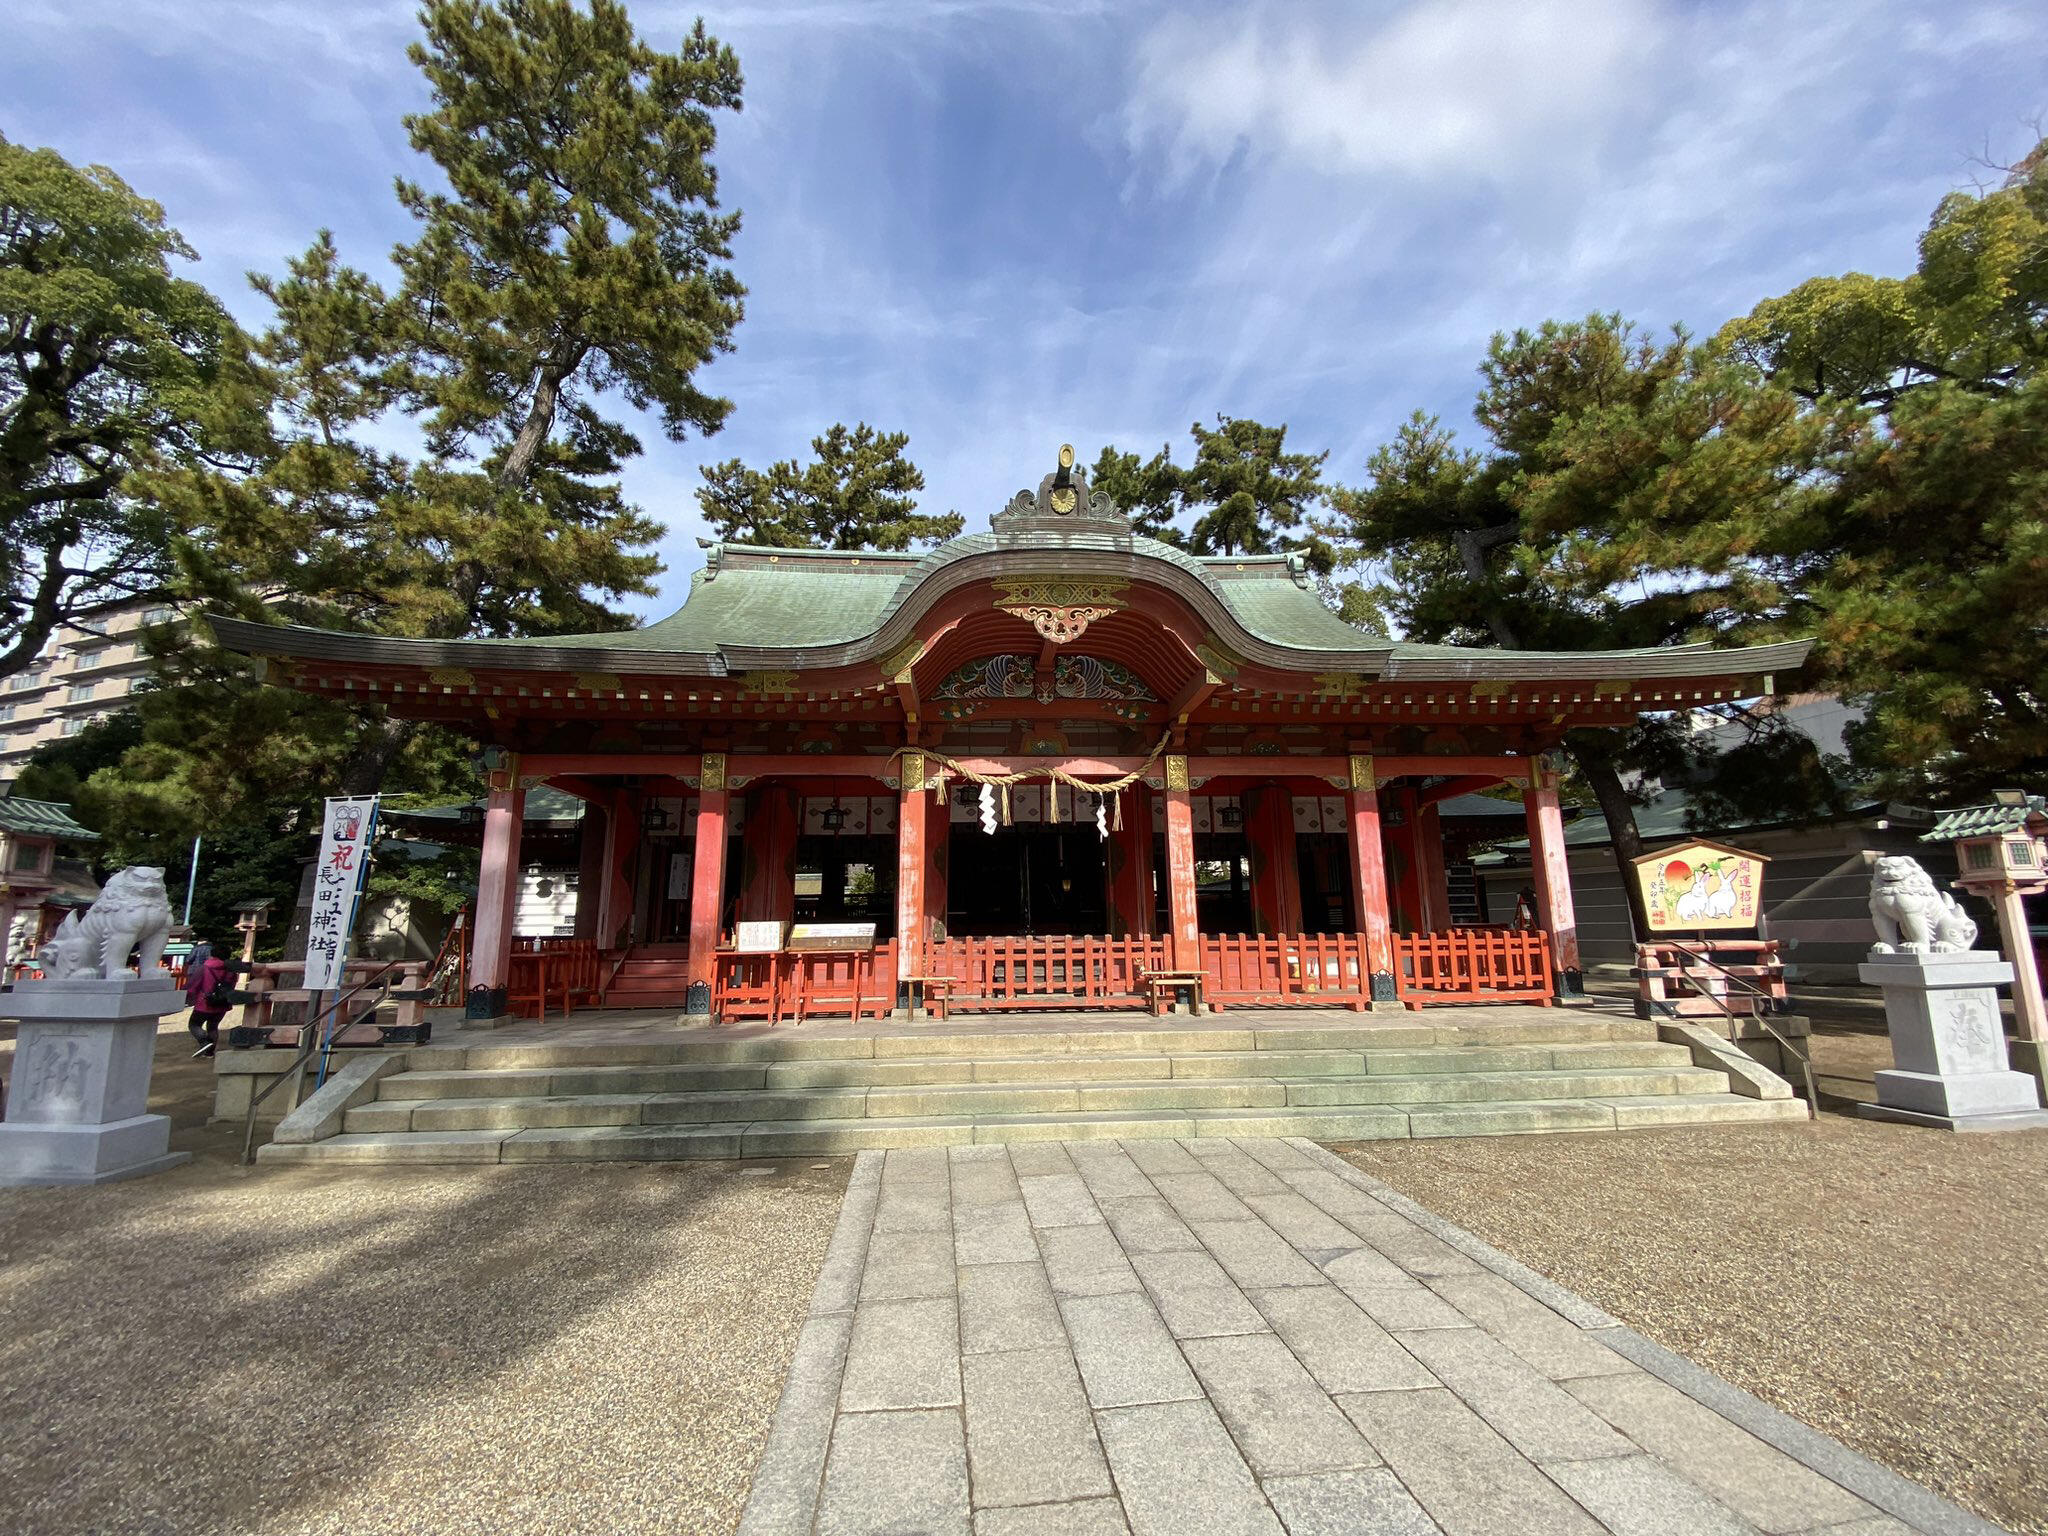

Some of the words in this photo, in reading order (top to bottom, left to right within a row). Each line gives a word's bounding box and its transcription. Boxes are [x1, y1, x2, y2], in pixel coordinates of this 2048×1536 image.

[329, 844, 354, 871] 祝
[309, 866, 335, 951] 長田神社
[1739, 859, 1752, 917] 開運招福
